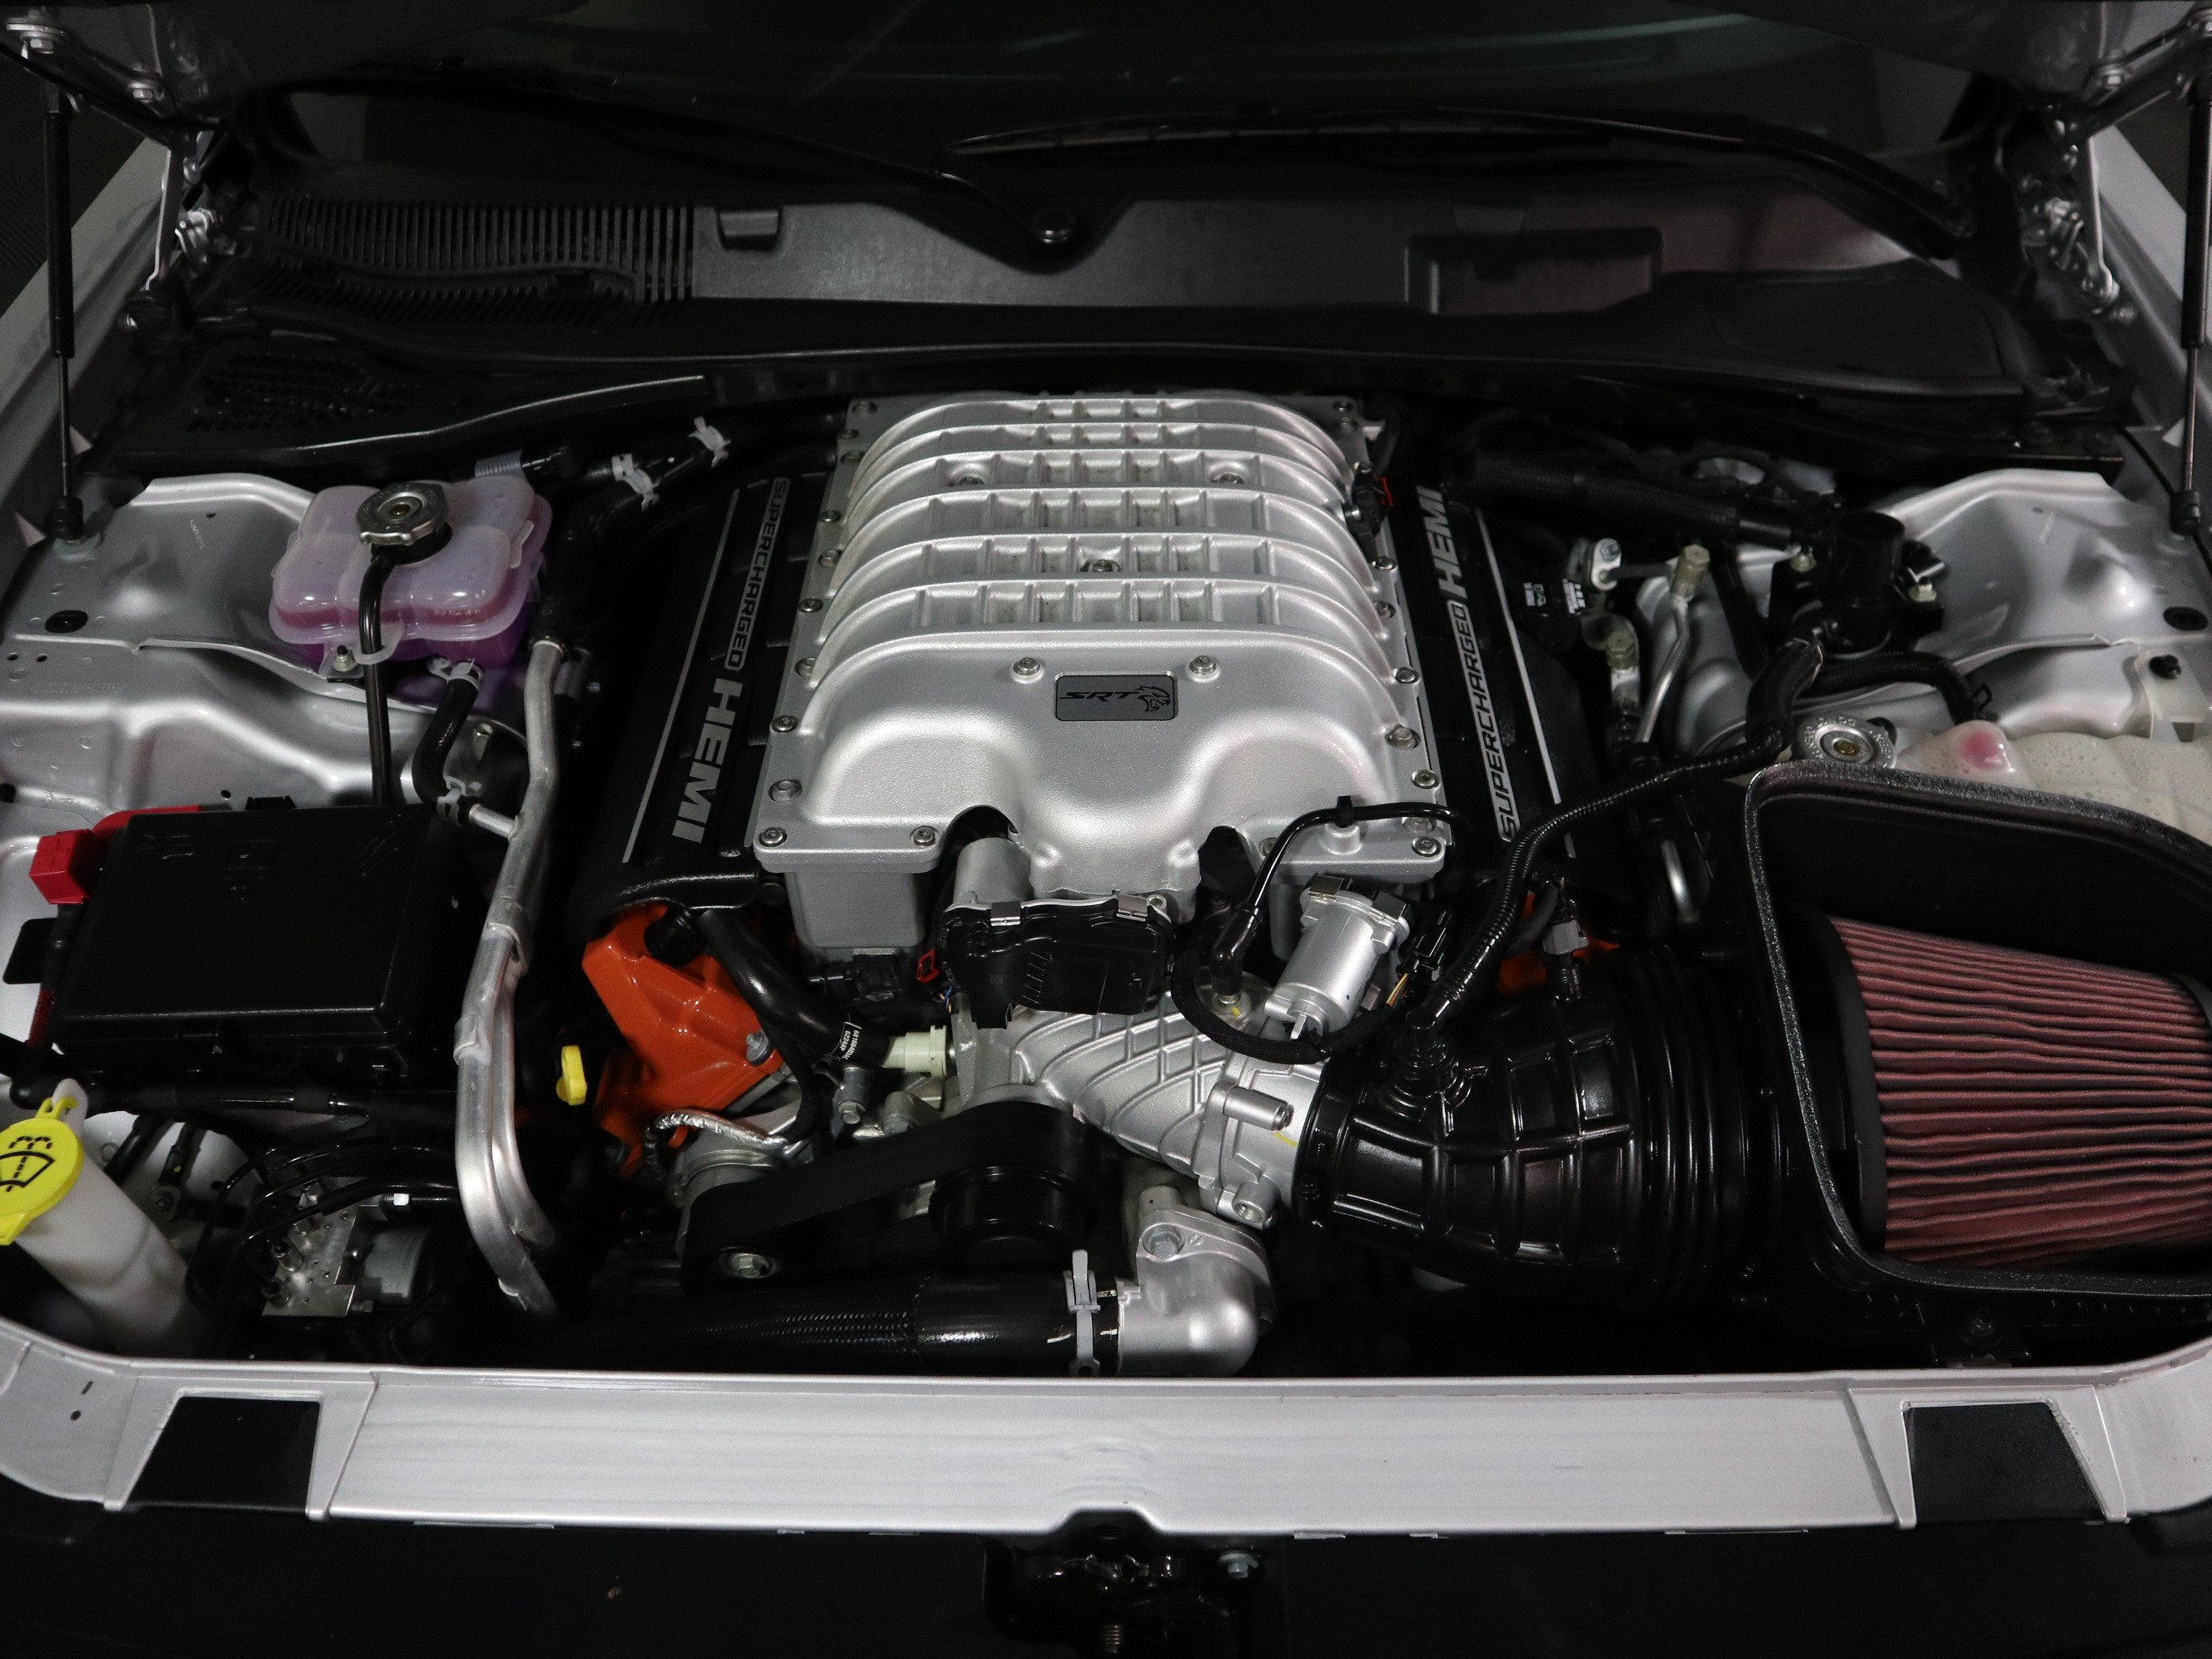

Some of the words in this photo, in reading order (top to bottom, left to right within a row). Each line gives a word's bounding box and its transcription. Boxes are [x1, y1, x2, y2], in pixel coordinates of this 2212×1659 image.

[727, 478, 789, 669] SUPERCHARGED
[1416, 485, 1467, 600] HEMI
[672, 678, 744, 844] HEMI
[1059, 691, 1139, 701] SRT
[1449, 601, 1519, 840] SUPERCHARGED
